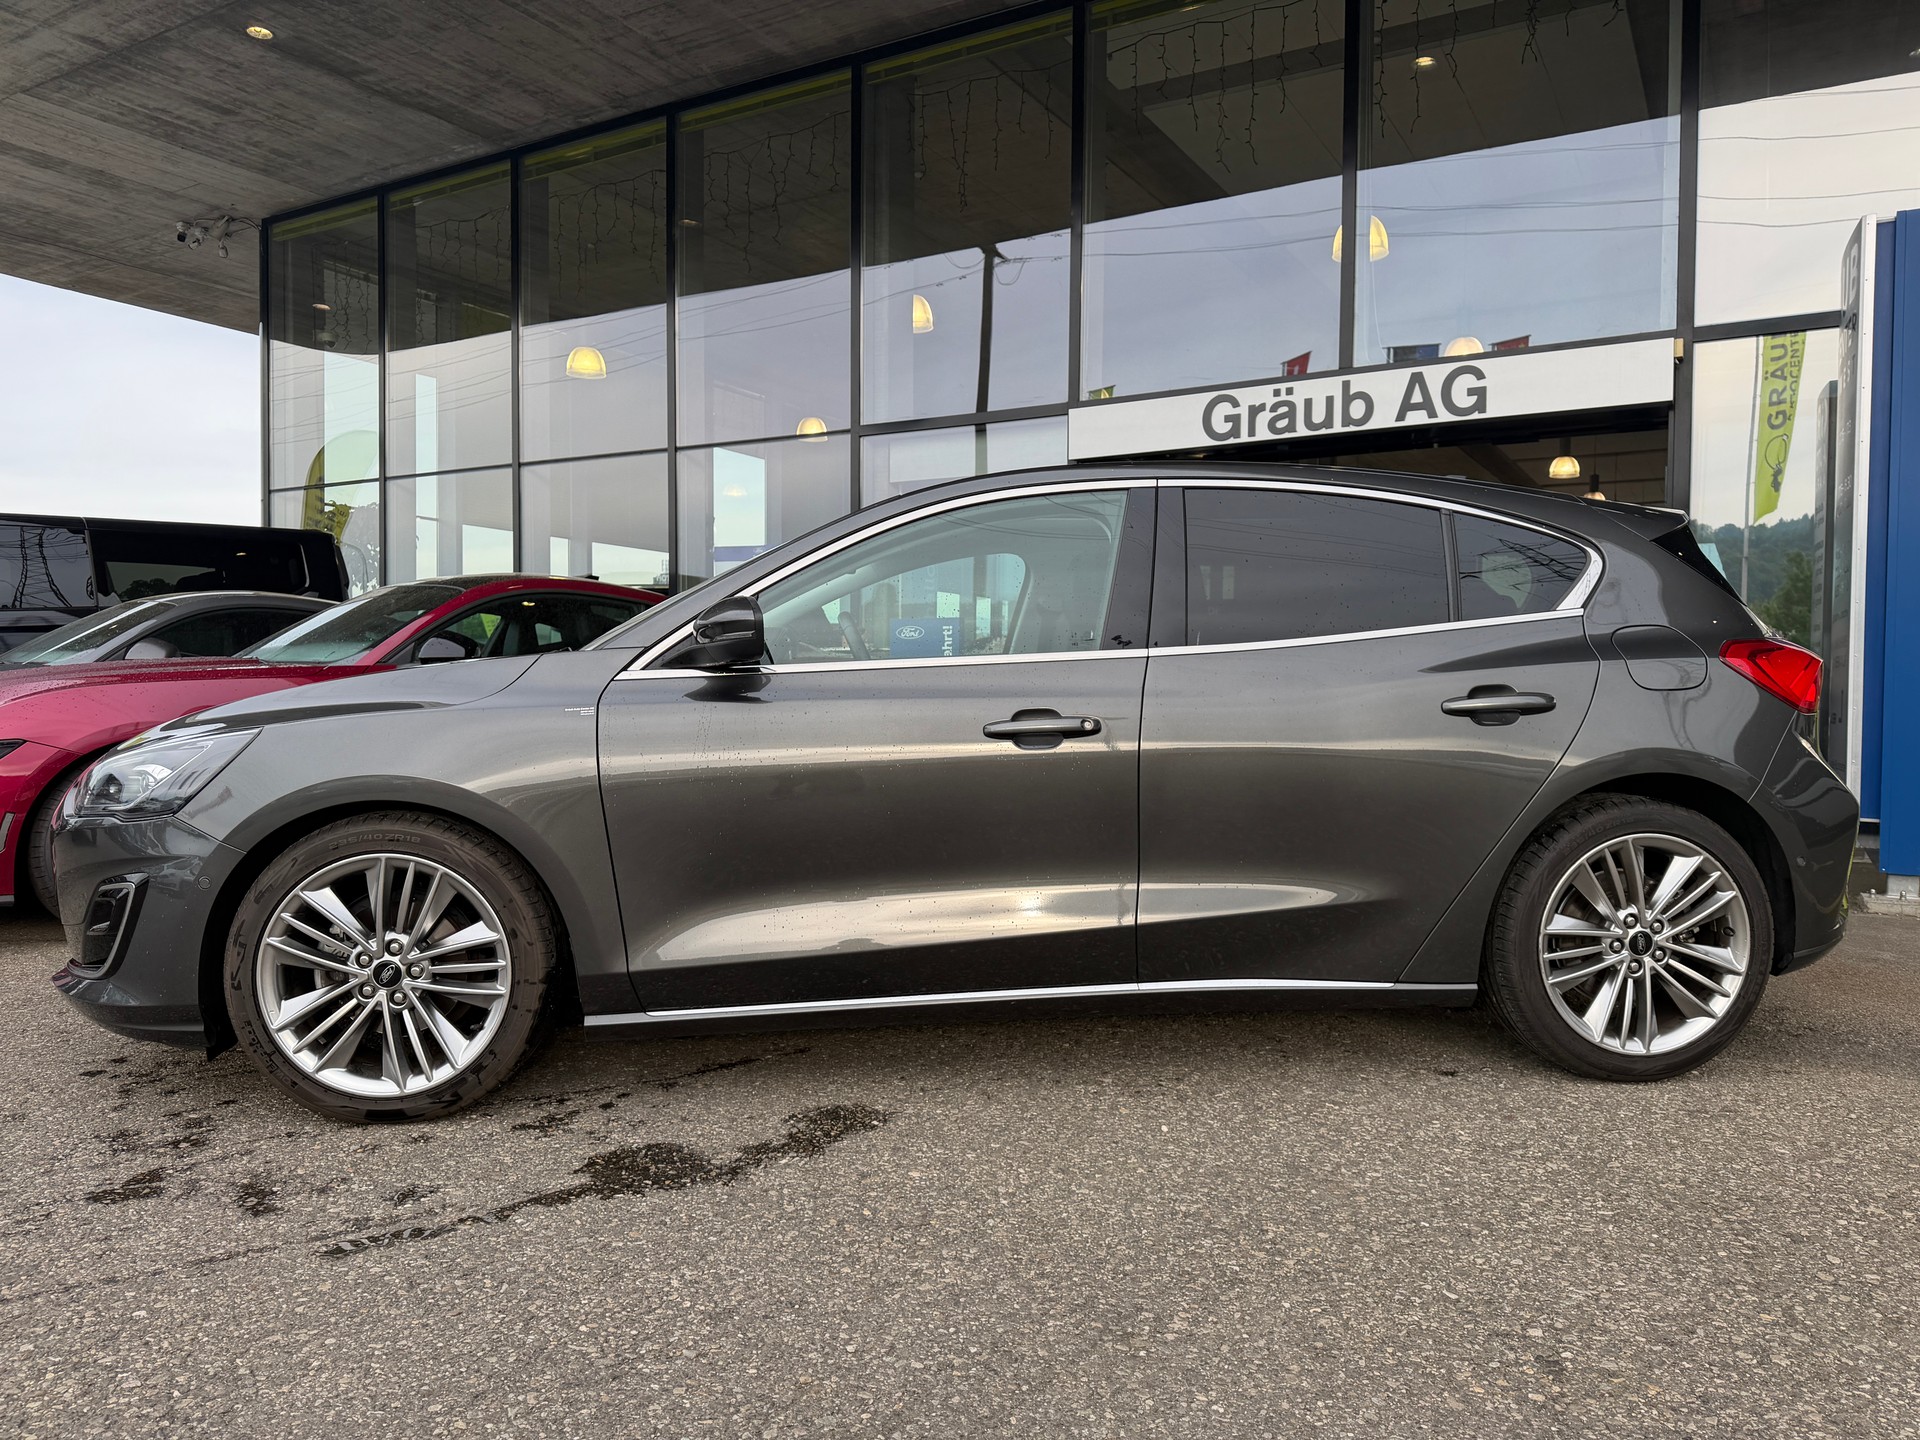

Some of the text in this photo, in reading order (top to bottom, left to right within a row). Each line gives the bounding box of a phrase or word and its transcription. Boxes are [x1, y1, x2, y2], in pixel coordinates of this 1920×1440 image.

[1202, 365, 1487, 442] Gräub AG
[898, 626, 922, 638] Ford
